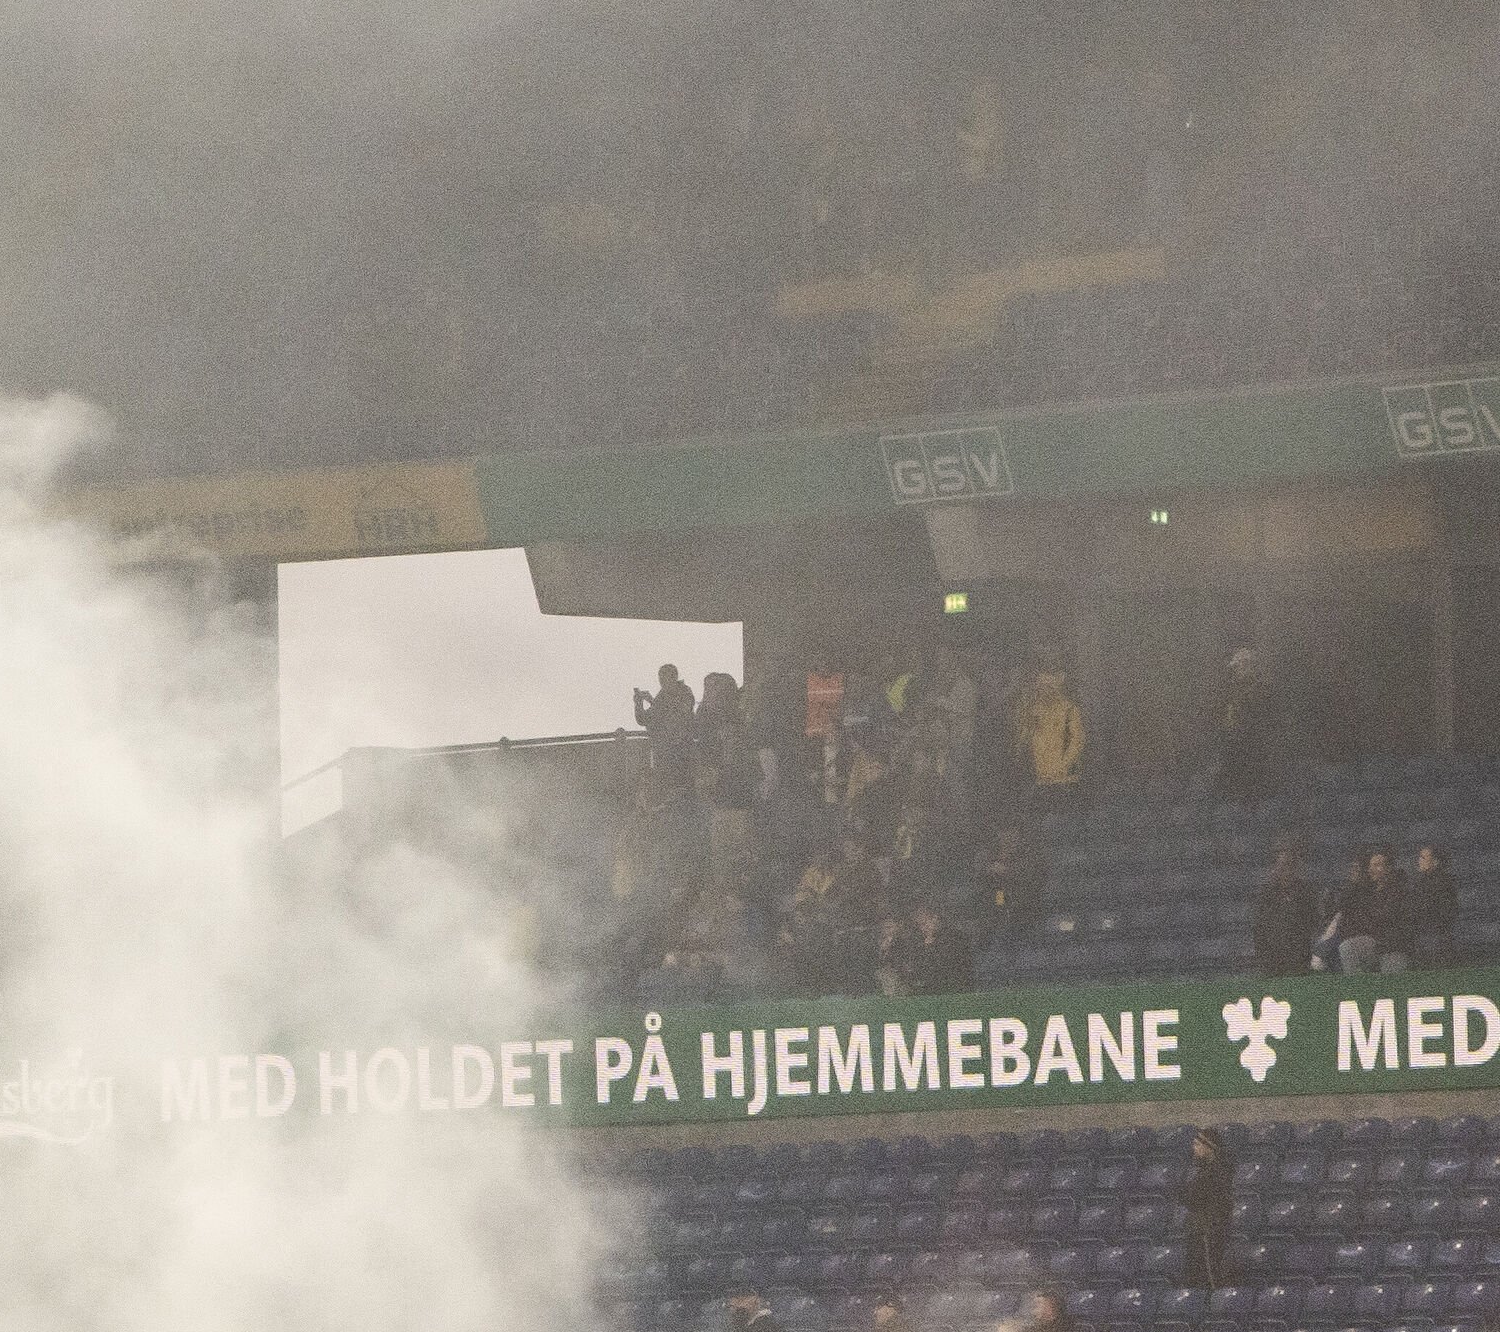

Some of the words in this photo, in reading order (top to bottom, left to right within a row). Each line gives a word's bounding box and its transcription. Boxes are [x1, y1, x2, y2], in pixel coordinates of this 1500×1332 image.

[893, 451, 998, 497] GSV
[160, 1053, 297, 1123] MED
[318, 1039, 574, 1116] HOLDET
[594, 1012, 680, 1104] PÅ
[701, 1008, 1182, 1114] HJEMMEBANE
